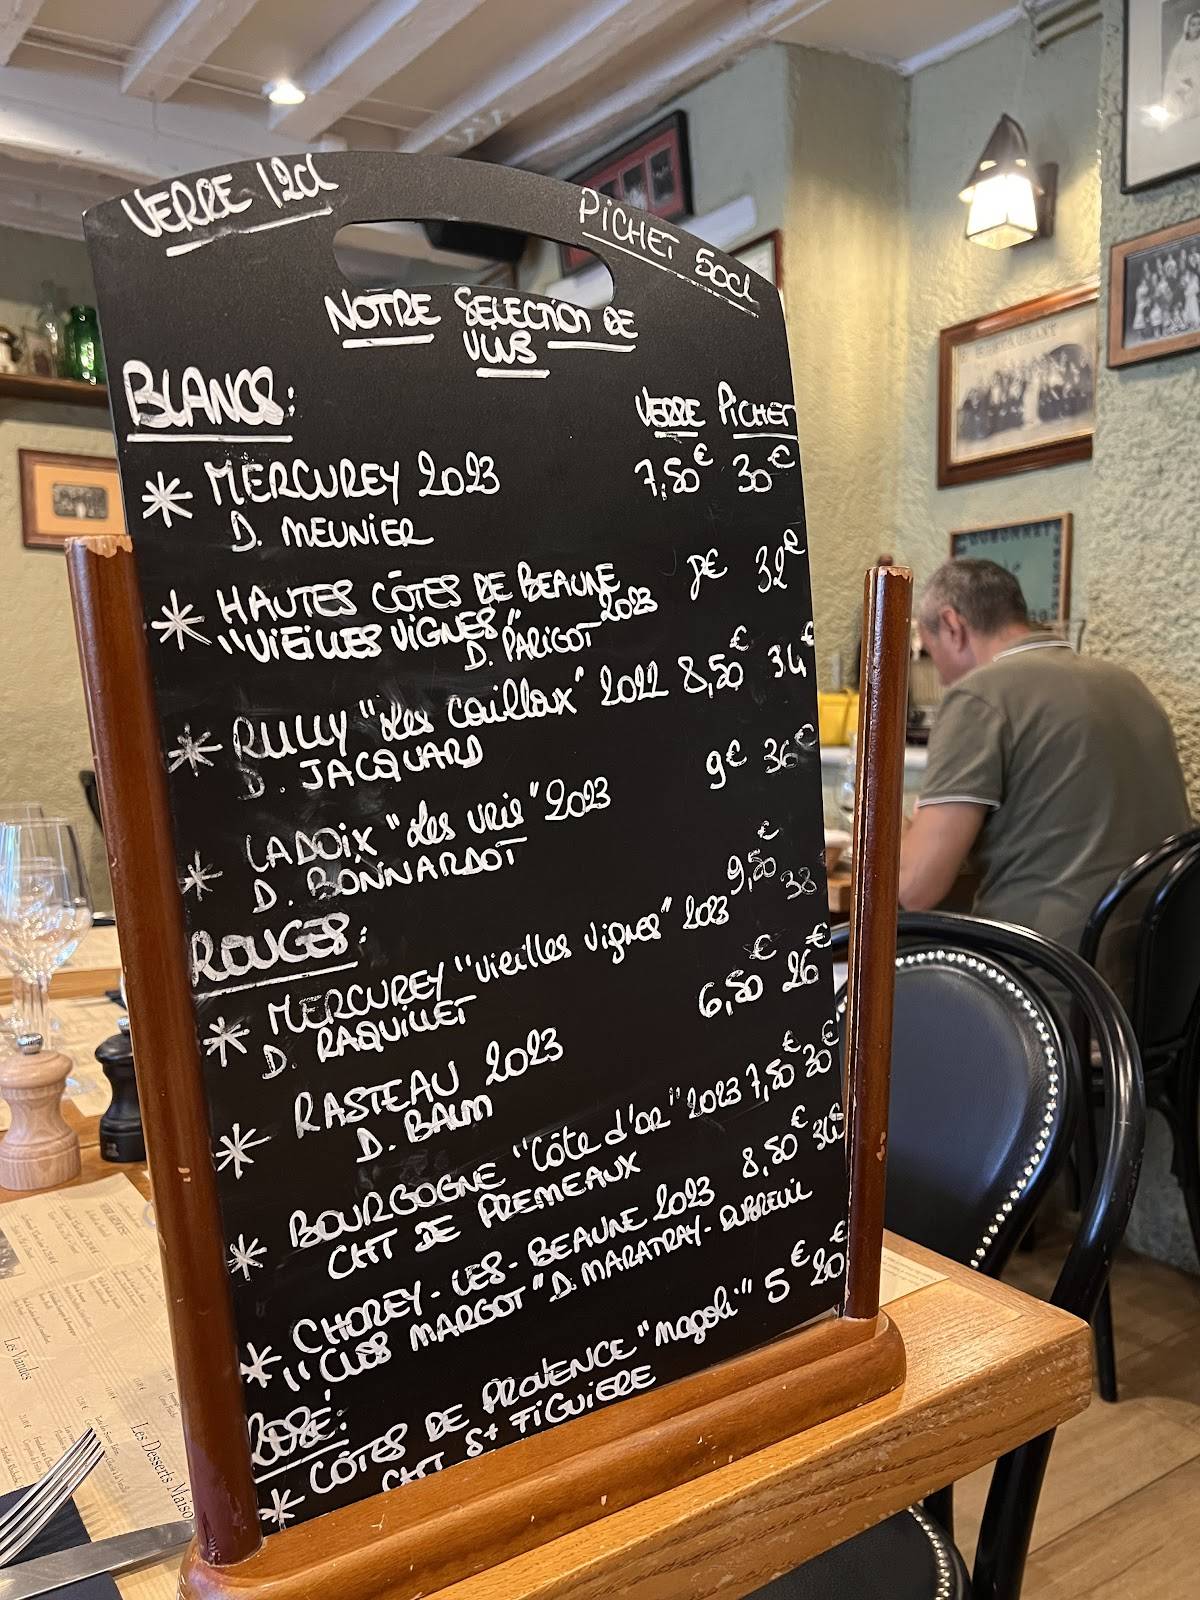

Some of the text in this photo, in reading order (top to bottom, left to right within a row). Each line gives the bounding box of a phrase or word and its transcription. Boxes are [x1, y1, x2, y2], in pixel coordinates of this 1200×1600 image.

[121, 152, 339, 237] VERRE 12cl
[695, 248, 760, 303] 50cl
[324, 288, 442, 335] NOTRE
[603, 306, 639, 339] DE
[635, 386, 706, 427] VERRE
[203, 457, 400, 505] MERCUREY
[418, 450, 500, 497] 2023
[230, 510, 263, 552] D.
[216, 579, 357, 625] HAUTES
[473, 570, 514, 605] DE
[517, 561, 620, 602] BEAUNE
[600, 586, 658, 622] 2023
[464, 640, 494, 671] D.
[232, 709, 347, 760] RULLY
[600, 660, 669, 706] 2022
[237, 734, 483, 800] D. JACQUARD
[544, 776, 612, 820] 2023
[253, 878, 294, 913] D.
[267, 961, 445, 1035] MERCUREY
[683, 895, 730, 930] 2023
[262, 1044, 298, 1079] D.
[294, 1060, 459, 1139] RASTEAU
[486, 1026, 563, 1086] 2023
[289, 1162, 506, 1248] BOURGOGNE
[687, 1076, 742, 1119] 2023
[356, 1127, 397, 1163] D.
[328, 1151, 641, 1279] CHT DE PREMEAUX
[292, 1280, 422, 1353] CHOREY
[527, 1206, 648, 1267] BEAUNE
[653, 1175, 716, 1222] 2023
[4, 1336, 21, 1352] Les
[12, 1349, 40, 1382] Viandes
[309, 1422, 408, 1494] CÔTES
[424, 1403, 470, 1442] DE
[482, 1338, 638, 1413] PROVENCE
[130, 1421, 149, 1443] Les
[142, 1439, 174, 1485] Desserts
[166, 1481, 194, 1520] Maiso
